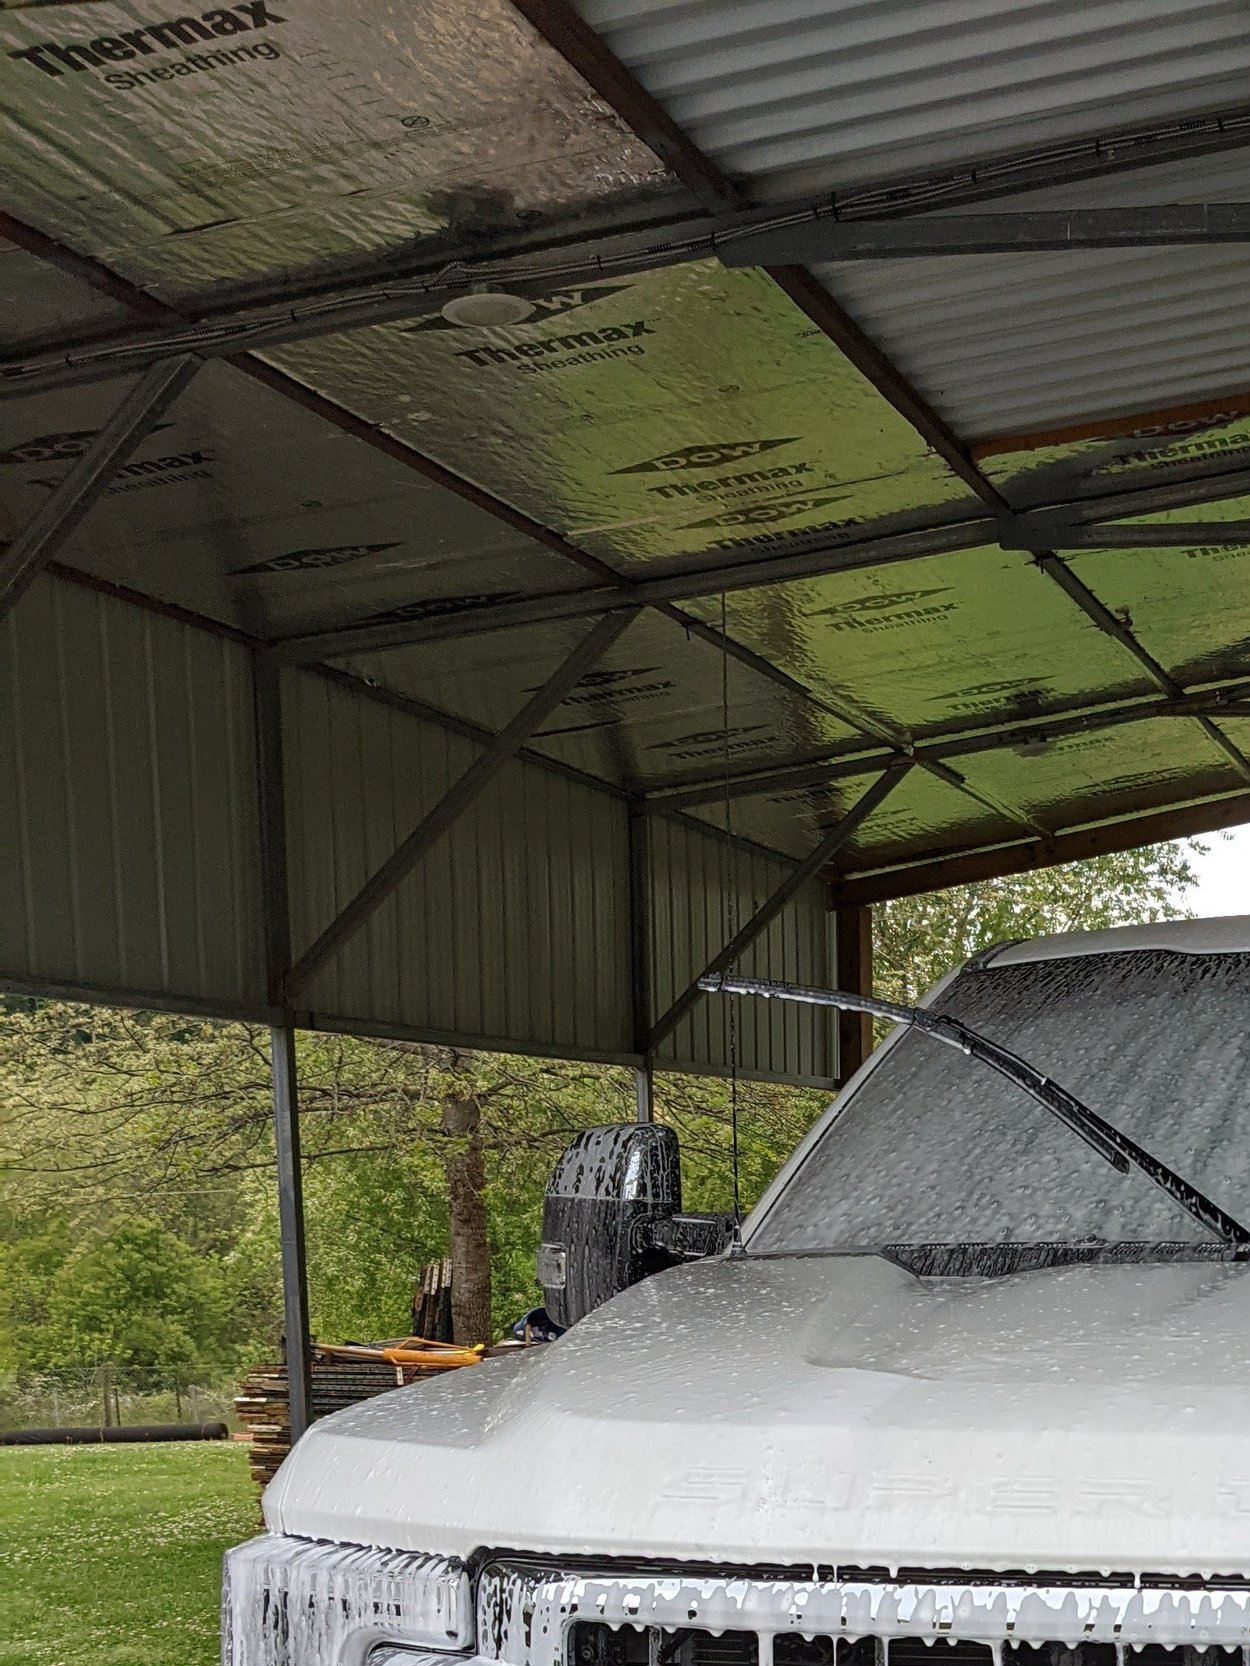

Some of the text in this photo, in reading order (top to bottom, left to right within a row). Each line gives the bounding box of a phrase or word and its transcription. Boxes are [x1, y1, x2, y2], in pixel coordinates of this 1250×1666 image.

[12, 0, 290, 77] Thermax
[104, 41, 281, 91] Sheathing
[454, 320, 658, 368] Thermax
[516, 344, 646, 374] Sheathing
[652, 443, 760, 470] DOW
[647, 461, 816, 499] Thermax
[714, 500, 815, 526] DOW
[825, 602, 960, 632] Thermax
[655, 1463, 1172, 1518] SUPER
